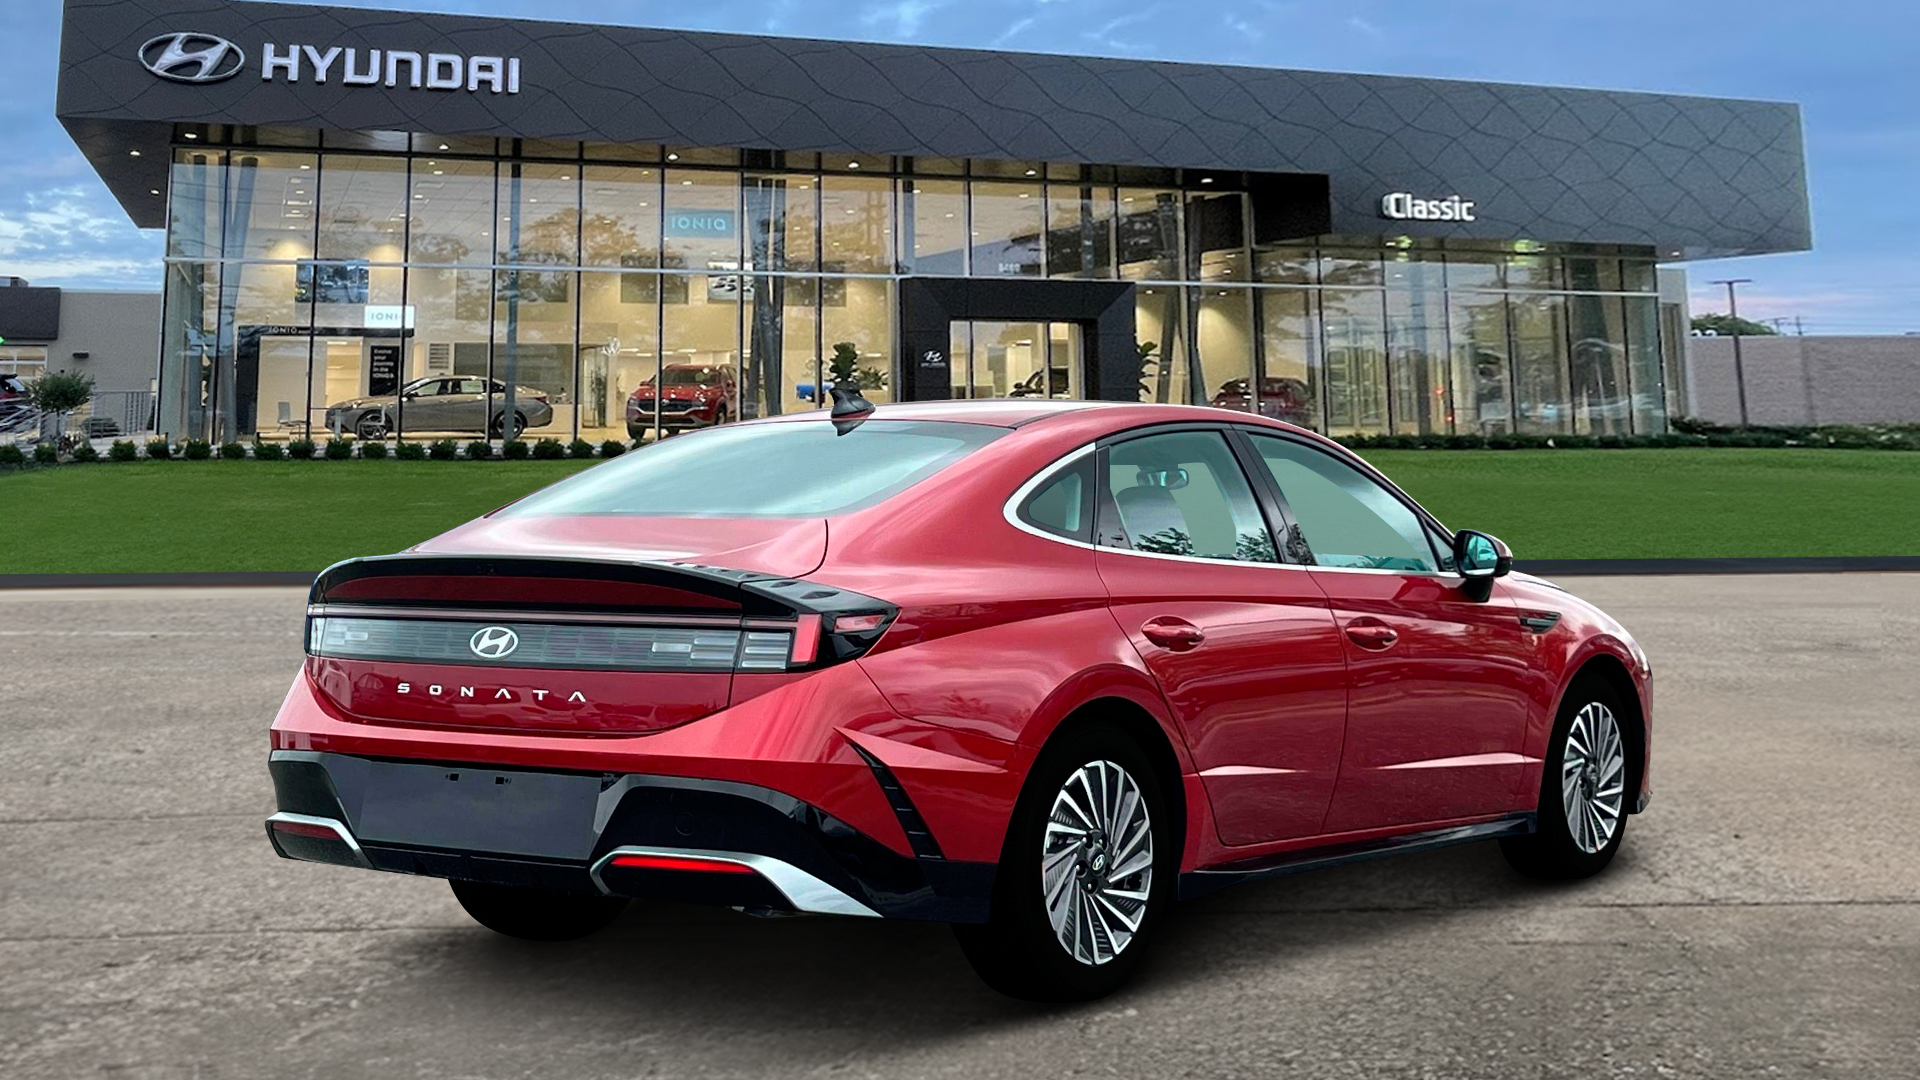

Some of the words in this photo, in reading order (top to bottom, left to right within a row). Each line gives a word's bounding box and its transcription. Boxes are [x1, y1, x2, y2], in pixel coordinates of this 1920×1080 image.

[261, 43, 520, 93] HYUNDAI
[1382, 192, 1476, 221] Classic
[671, 216, 726, 231] IONIQ
[371, 312, 403, 321] IONI
[397, 682, 586, 703] SONATA
